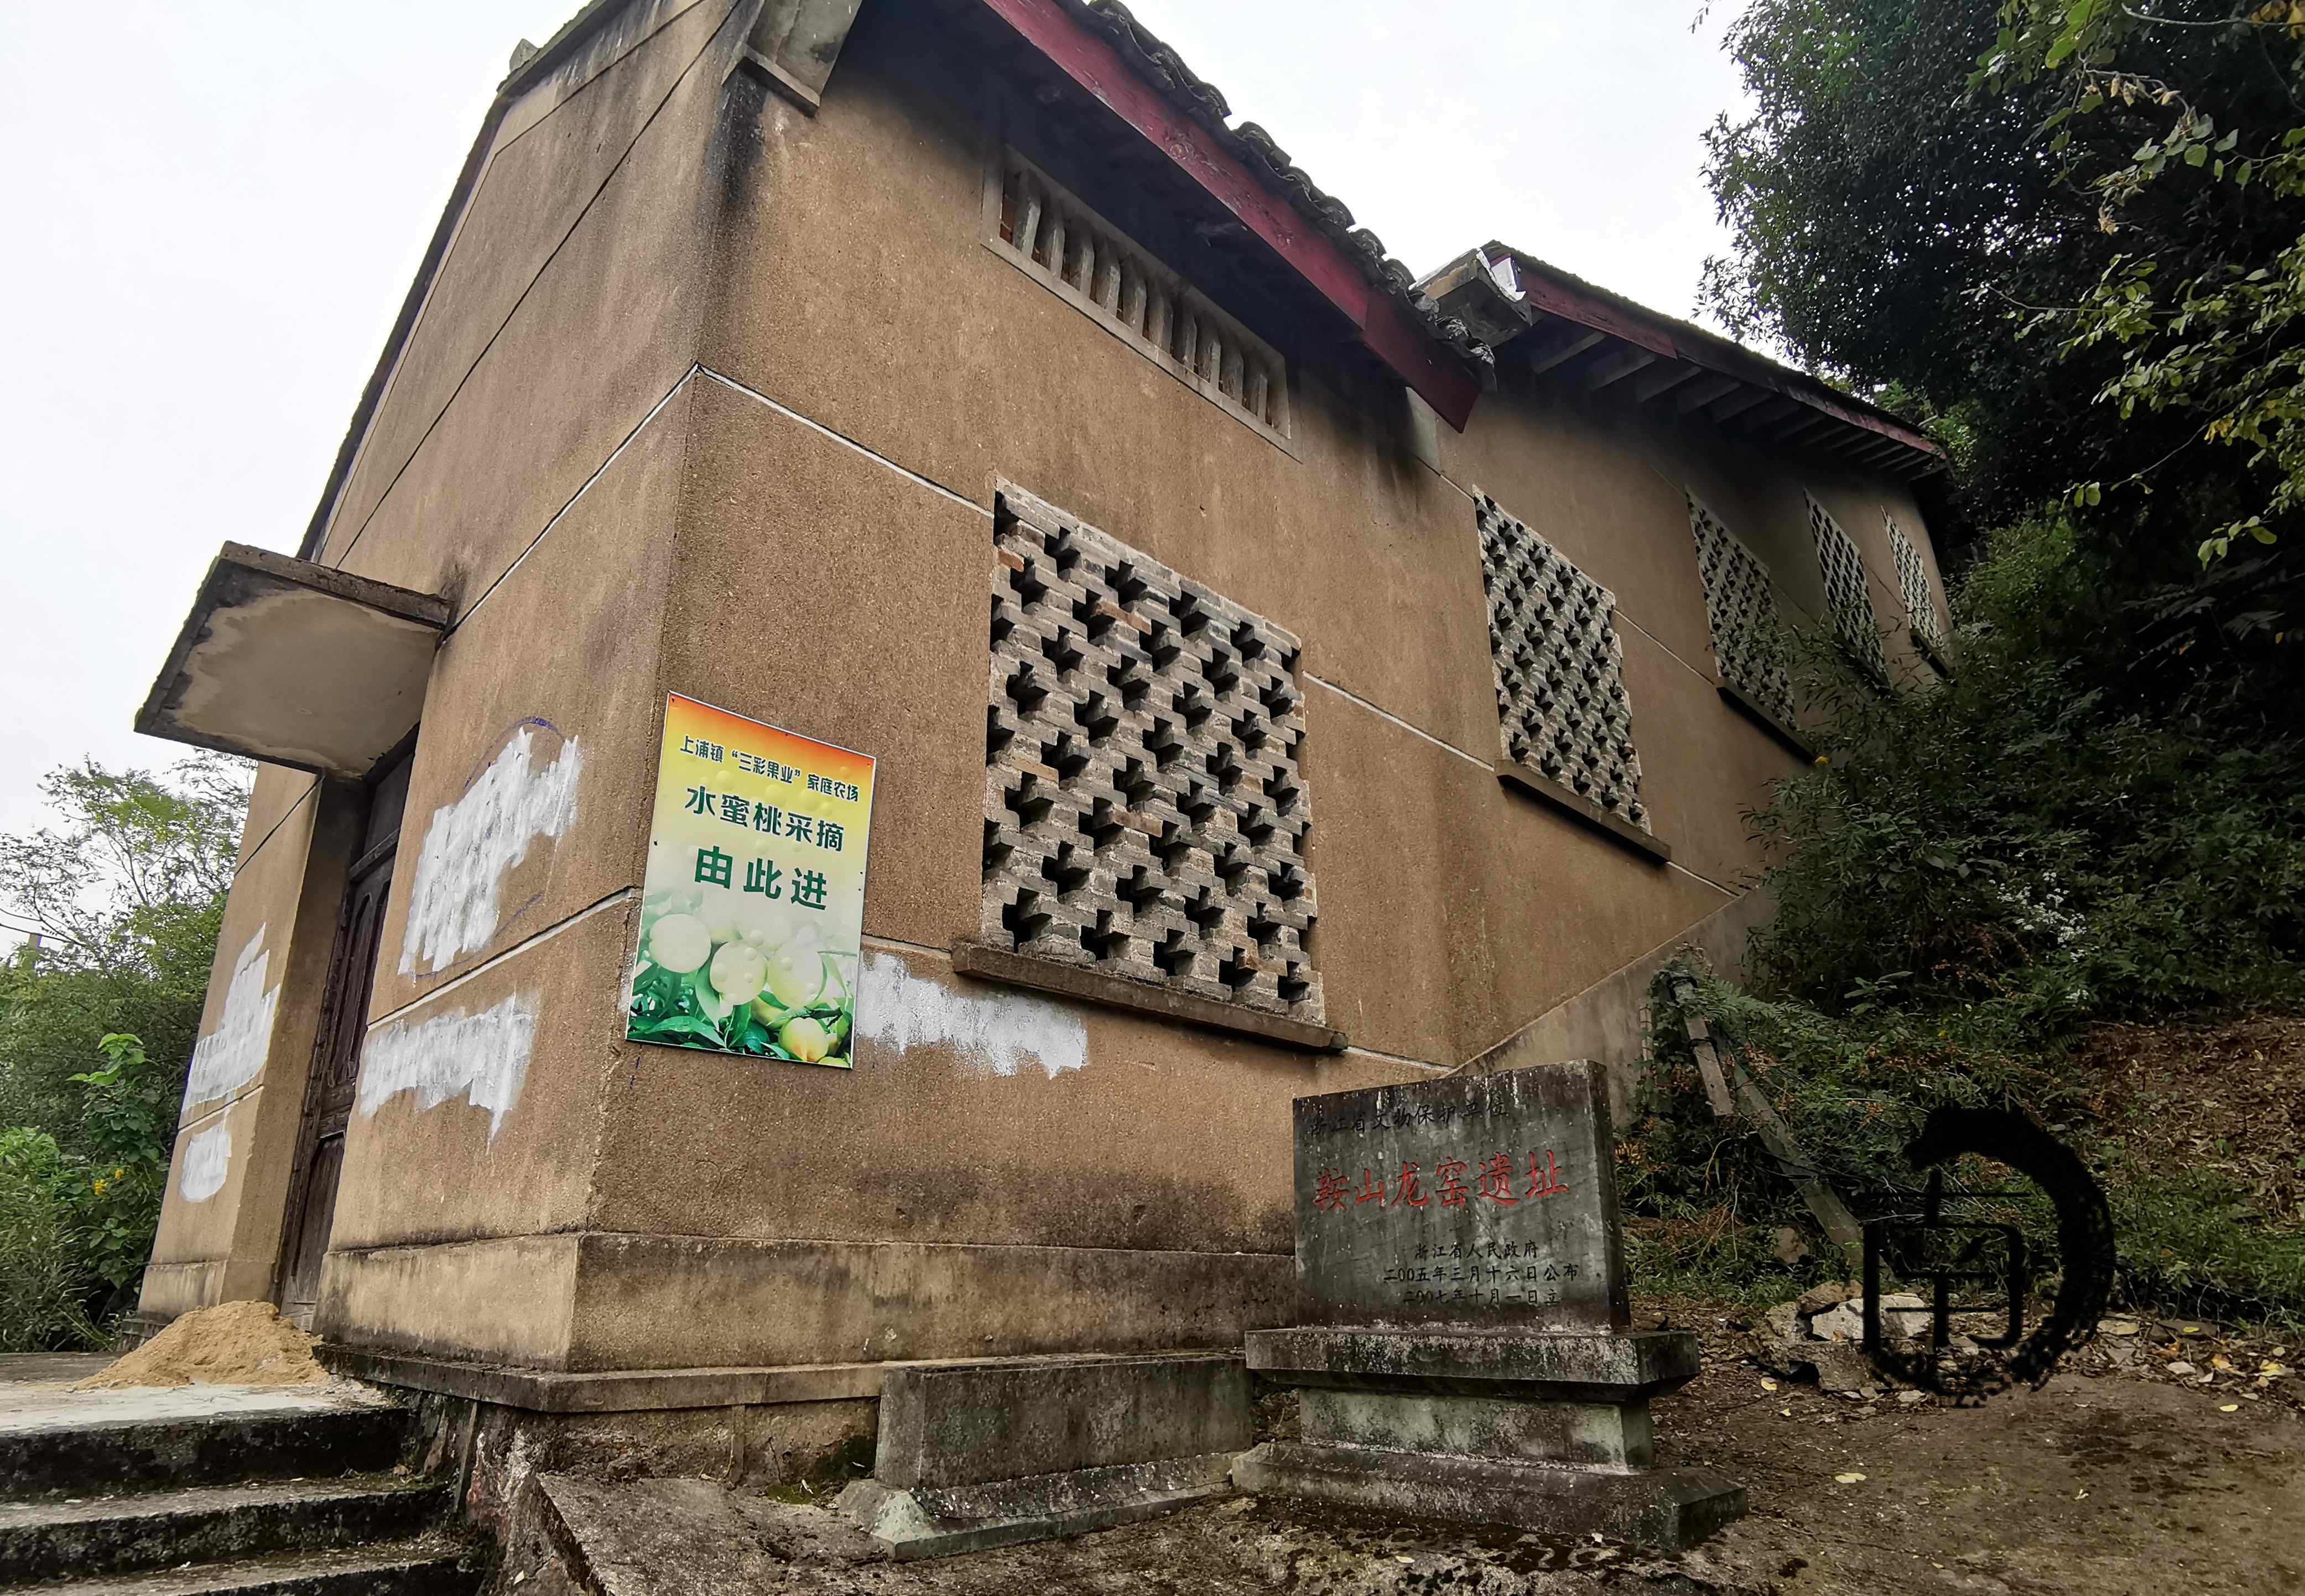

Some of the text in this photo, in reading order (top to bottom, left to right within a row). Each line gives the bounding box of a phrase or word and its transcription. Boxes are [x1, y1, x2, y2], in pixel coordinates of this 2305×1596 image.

[685, 785, 844, 851] 水蜜桃采摘
[695, 845, 828, 911] 由此进
[1314, 1150, 1570, 1212] 鞍山龙窑遗址
[1414, 1240, 1539, 1262] 浙江省人民政府
